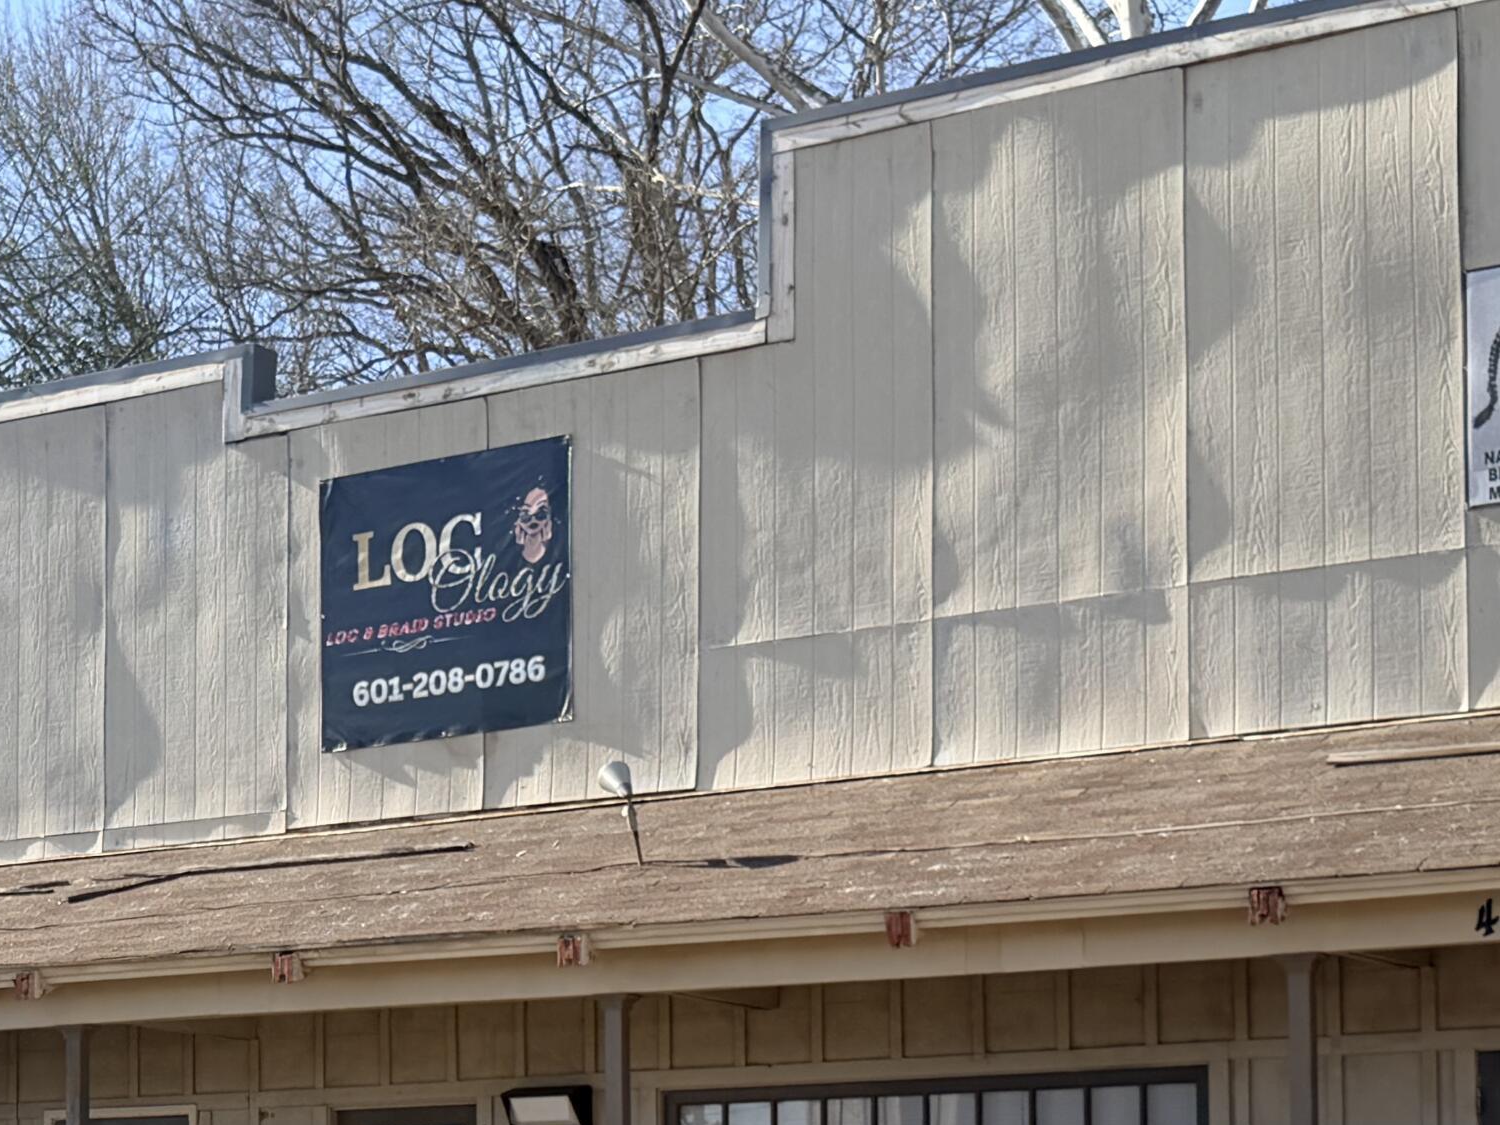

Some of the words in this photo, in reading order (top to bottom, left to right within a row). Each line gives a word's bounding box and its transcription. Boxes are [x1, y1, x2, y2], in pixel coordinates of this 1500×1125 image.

[352, 512, 482, 591] LOC
[428, 549, 564, 623] Ology
[326, 628, 358, 647] LOC
[377, 617, 429, 639] BRAID
[433, 607, 497, 629] STUDIO
[352, 655, 546, 707] 601-208-0786
